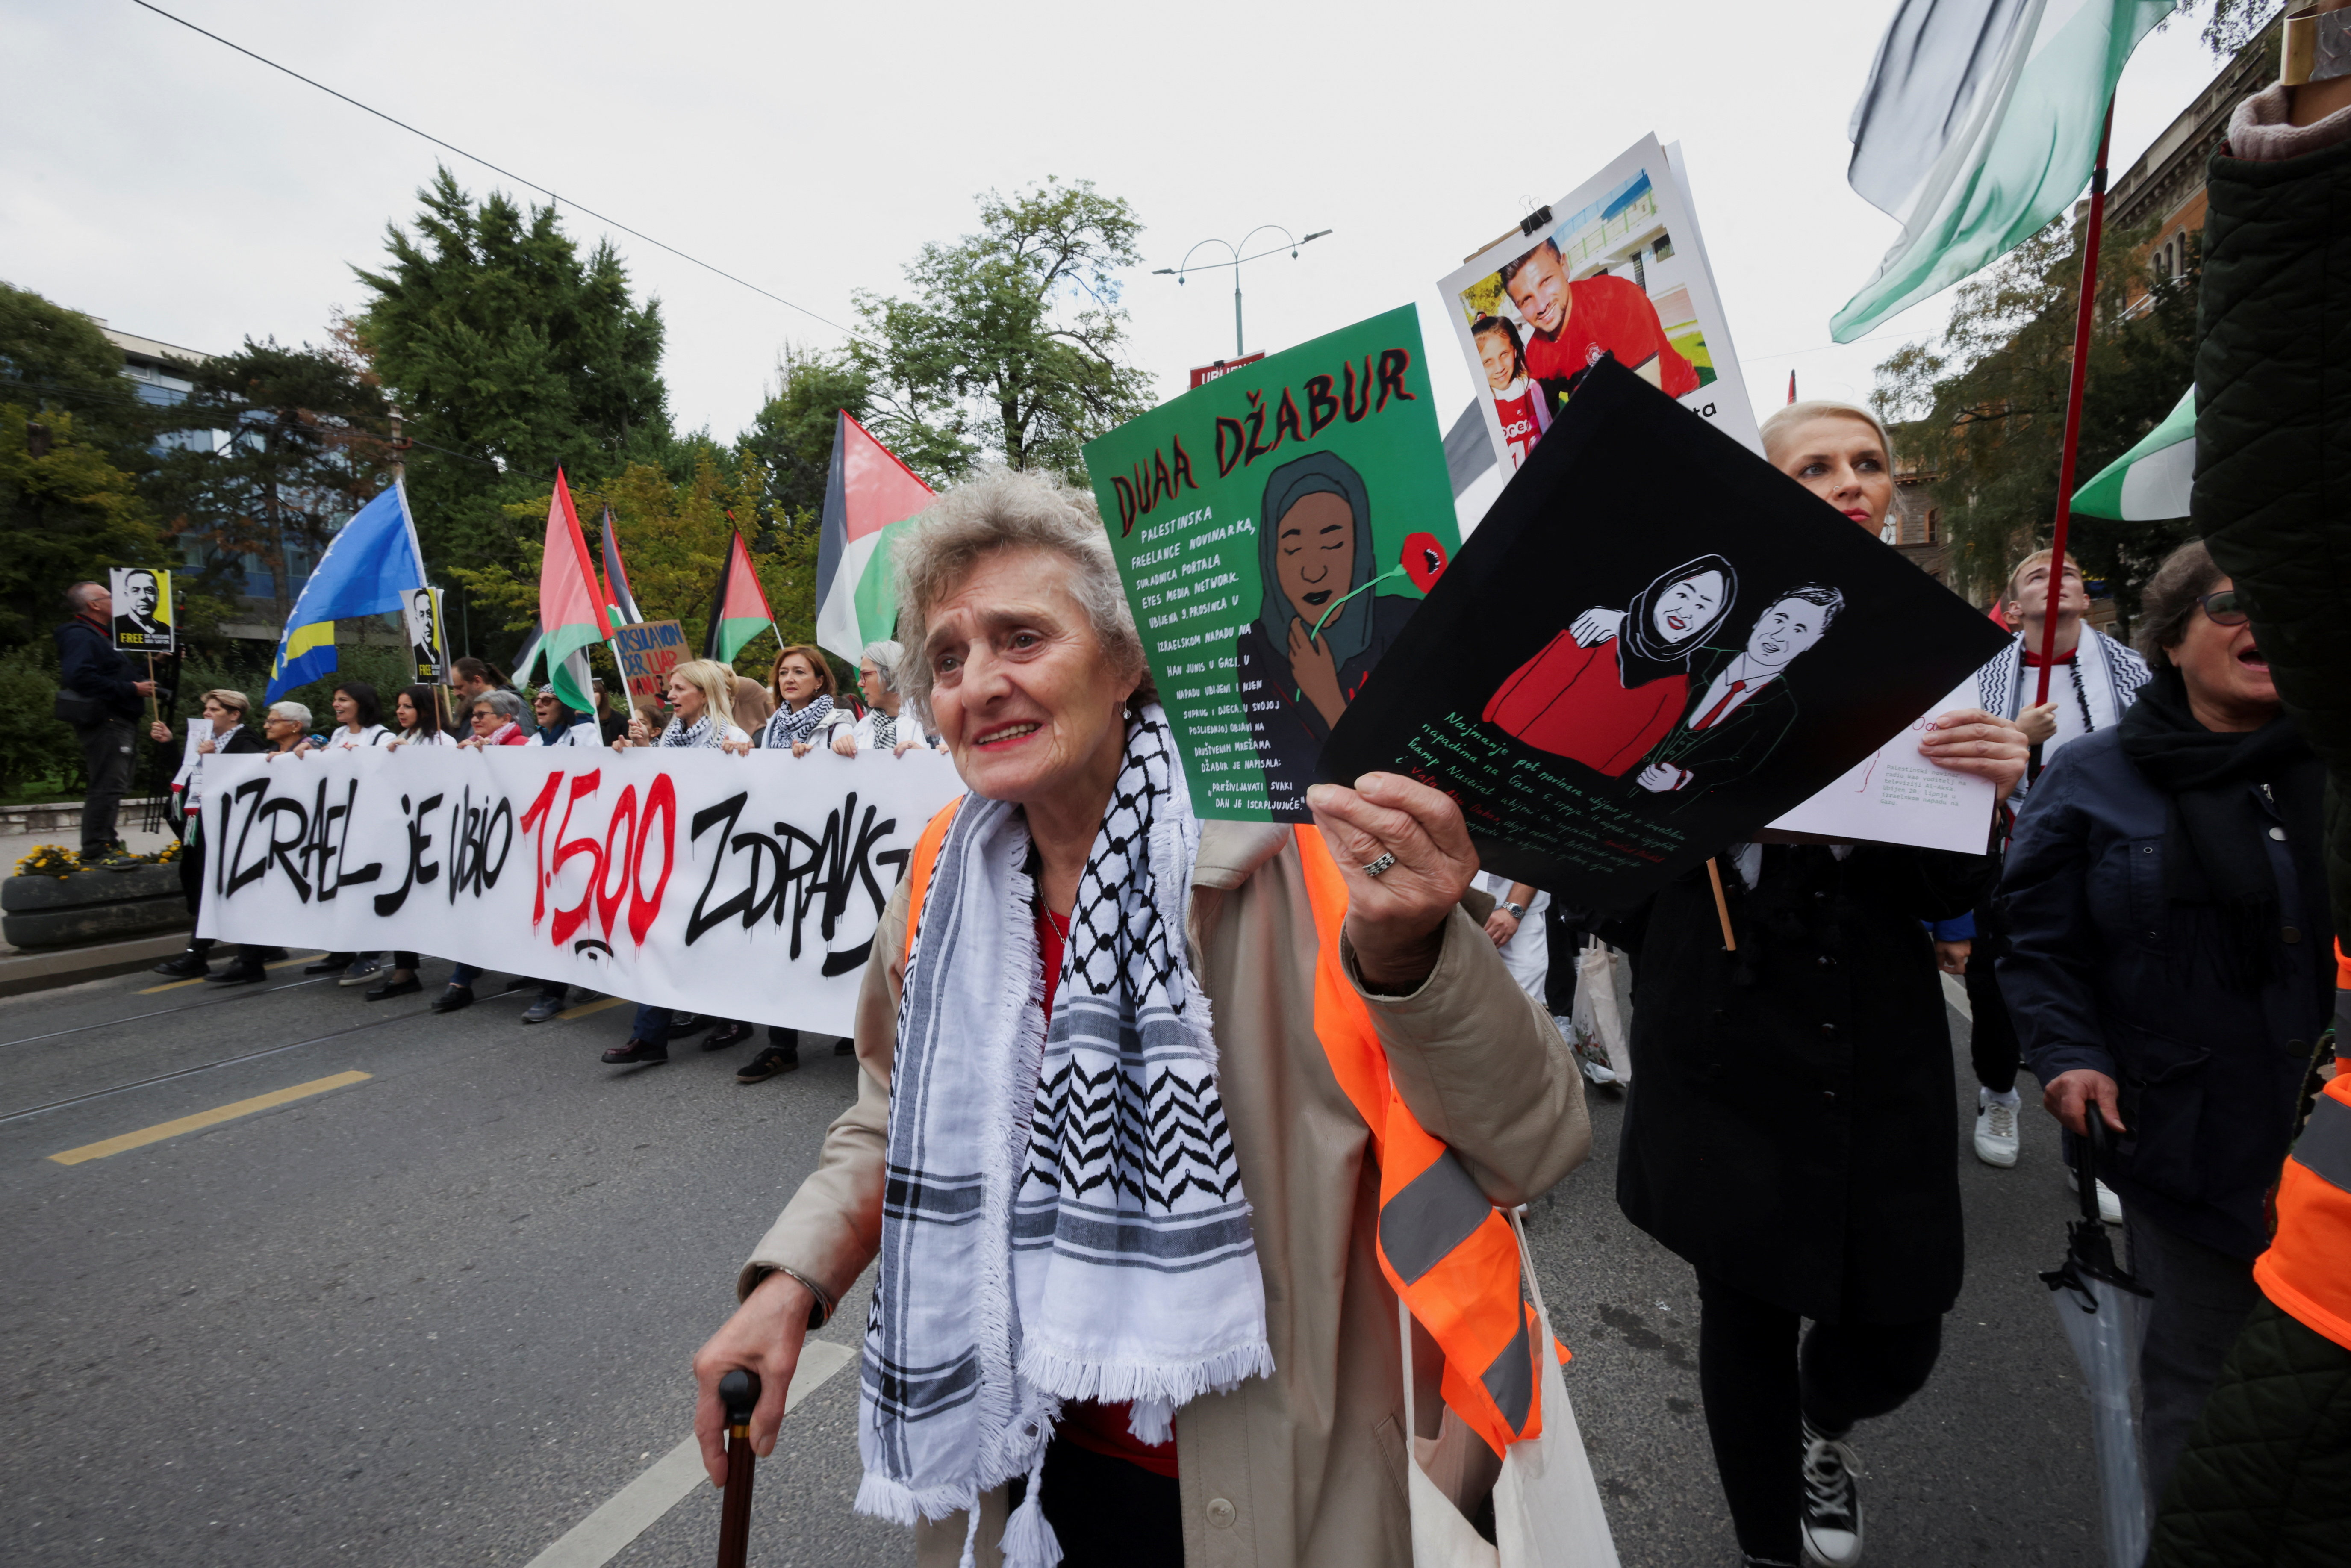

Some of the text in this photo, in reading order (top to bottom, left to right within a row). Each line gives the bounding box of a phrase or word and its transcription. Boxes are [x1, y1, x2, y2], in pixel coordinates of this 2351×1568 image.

[1110, 348, 1417, 538] DUAA DŽABUR
[1141, 506, 1212, 544] PALESTINSKA
[1131, 517, 1256, 570] FREELANCE NOVINARKA,
[1136, 554, 1221, 590] SURADNICA PORTALA
[1142, 572, 1239, 609] EYES MEDIA NETWORK
[1149, 612, 1178, 629] UBIJENA
[1232, 595, 1239, 606] U
[120, 633, 144, 643] FREE
[1157, 623, 1252, 652] IZRAELSKOM NAPADU NA
[419, 664, 432, 675] FREE
[621, 650, 678, 677] DER LIAR
[1167, 654, 1249, 677] HAN JUNIS U GAZI. U
[1176, 688, 1200, 700] NAPADU
[1205, 683, 1231, 696] UBIJENI
[1236, 683, 1239, 692] I
[1184, 709, 1208, 719] SUPRUG
[1243, 704, 1248, 713] U
[1252, 701, 1279, 712] SVOJOJ
[1230, 722, 1252, 733] OBJAVI
[1255, 722, 1264, 731] NA
[1194, 738, 1271, 757] DRUŠTVENIH MREŽAMA
[1201, 758, 1281, 773] DŽABUR JE NAPISALA:
[1422, 723, 1478, 763] napadima
[1483, 764, 1499, 775] na
[1509, 775, 1535, 793] Gazu
[1444, 712, 1509, 756] Najmanje
[1512, 759, 1540, 771] pet
[1538, 772, 1582, 796] novinara
[1589, 797, 1619, 811] ubijeno
[1614, 812, 1632, 820] je
[1408, 737, 1440, 766] kamp
[1446, 766, 1495, 795] Nuseirat
[1500, 798, 1540, 814] ubijeni
[1887, 764, 1927, 774] Palestinski
[1270, 781, 1293, 791] SVAKI
[1884, 778, 1921, 788] televiziji
[1923, 776, 1954, 786] voditelj
[1216, 798, 1229, 808] DAN
[1233, 799, 1242, 808] JE
[1882, 792, 1920, 801] izraelskom
[1925, 790, 1948, 799] lipnja
[1503, 821, 1527, 833] oboje
[218, 777, 382, 903] IZRAEL
[520, 768, 676, 947] 1.500
